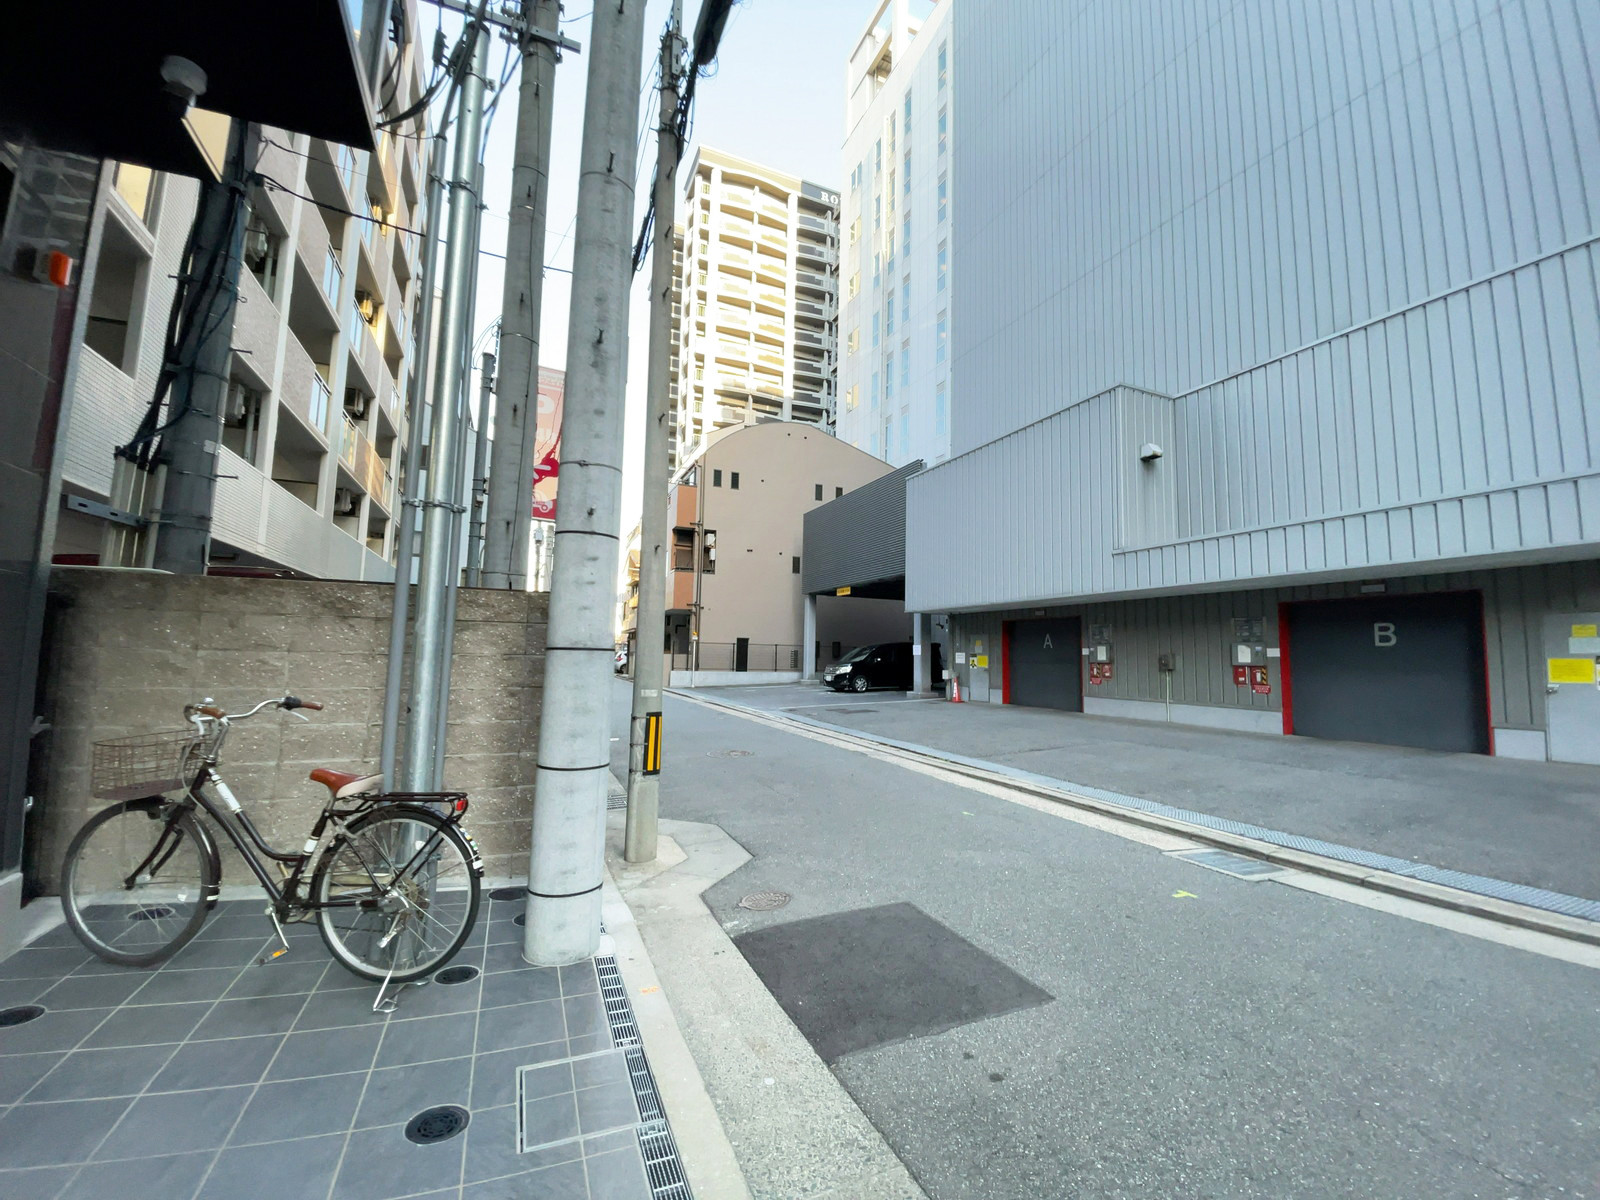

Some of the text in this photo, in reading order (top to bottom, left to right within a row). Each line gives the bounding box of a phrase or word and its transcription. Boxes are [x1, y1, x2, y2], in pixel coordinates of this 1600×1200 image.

[820, 191, 841, 204] RO
[1043, 633, 1053, 649] A
[1375, 623, 1398, 647] B
